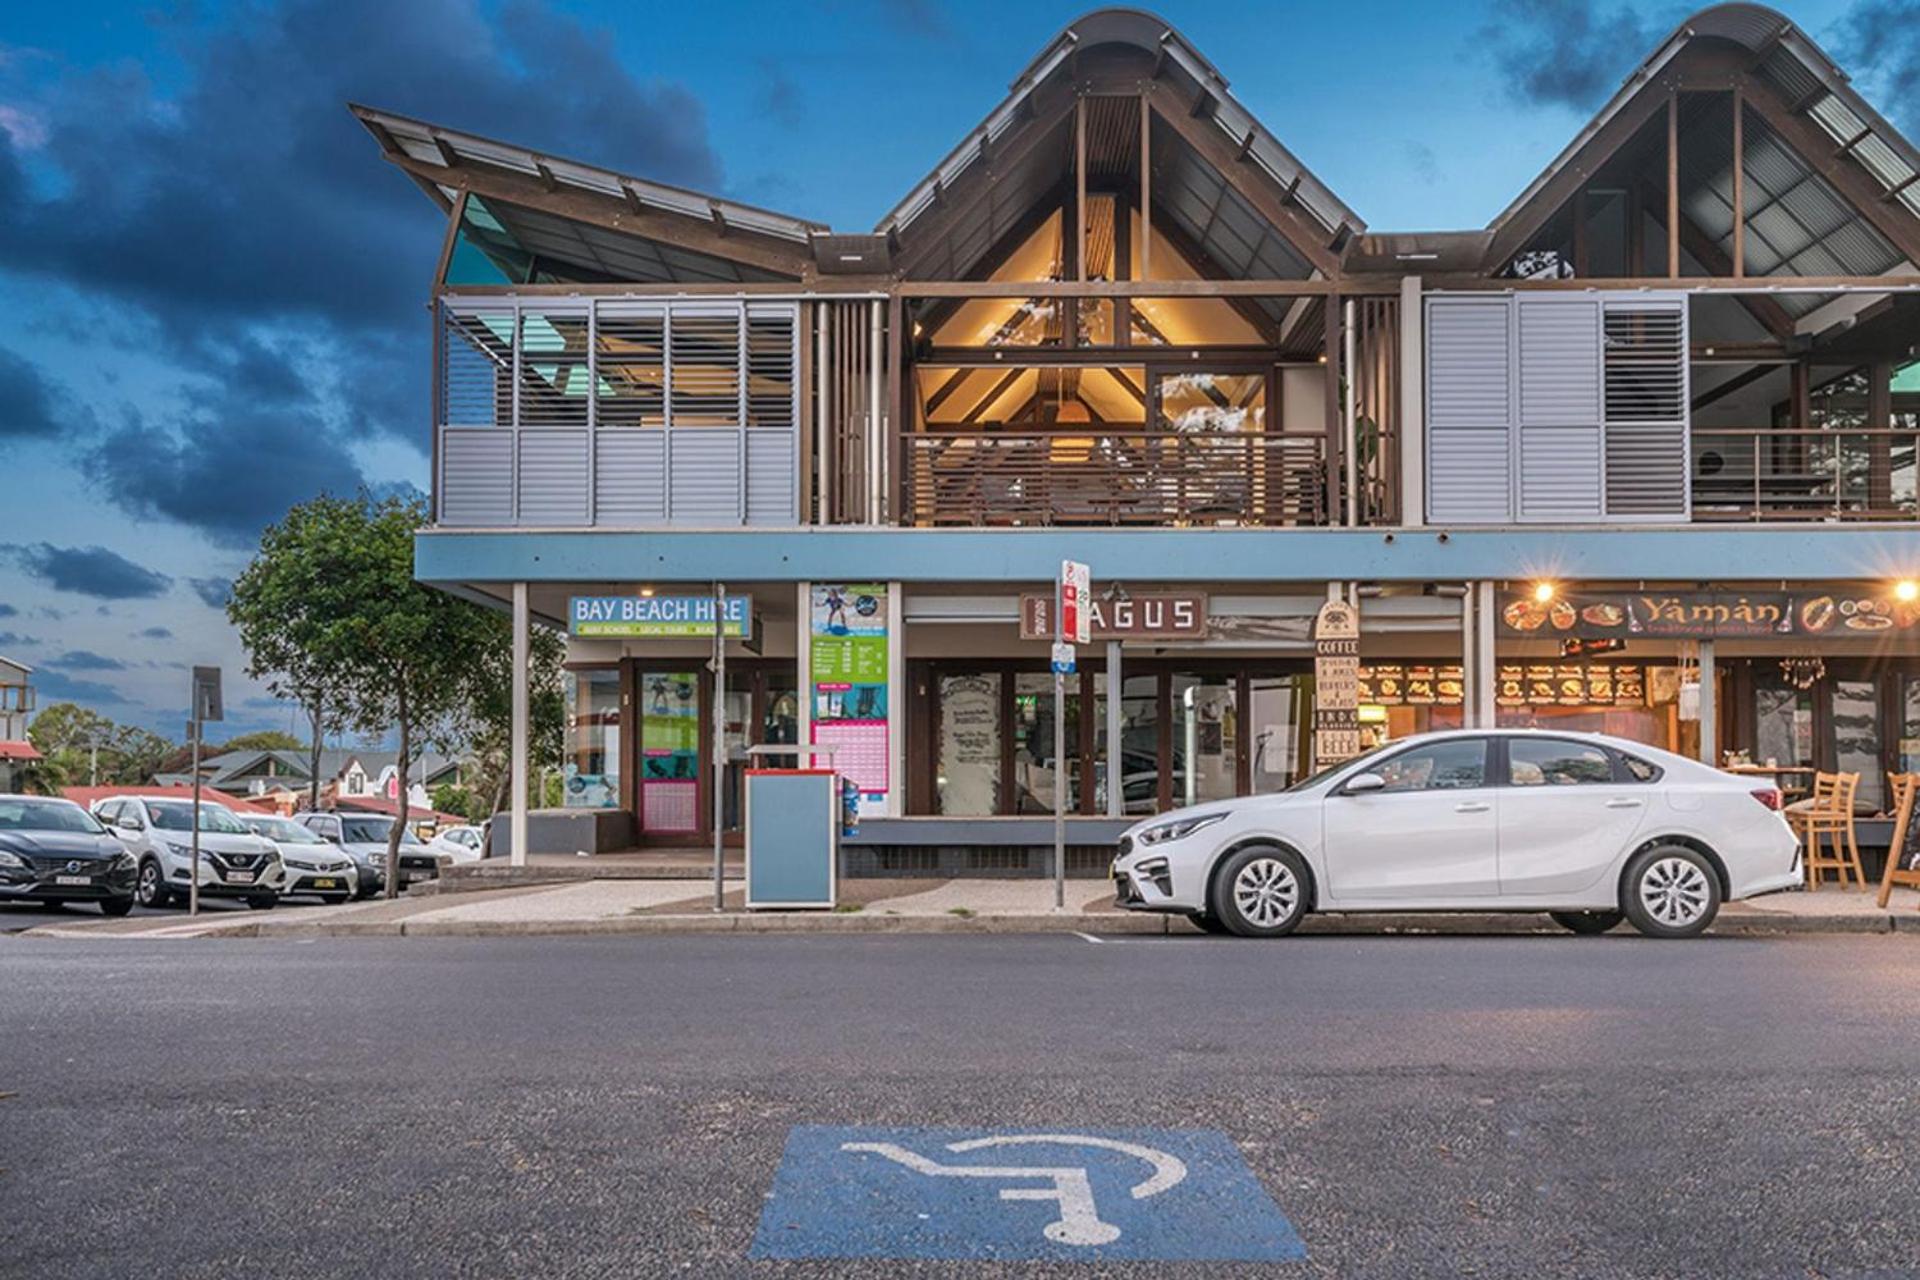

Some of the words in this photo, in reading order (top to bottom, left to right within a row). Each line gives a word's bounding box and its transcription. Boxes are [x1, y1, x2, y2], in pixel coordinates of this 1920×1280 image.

[577, 600, 616, 620] BAY
[622, 600, 688, 620] BEACH
[696, 600, 742, 620] HIRE
[1087, 601, 1193, 628] AGUS
[1318, 641, 1359, 654] COFFEE
